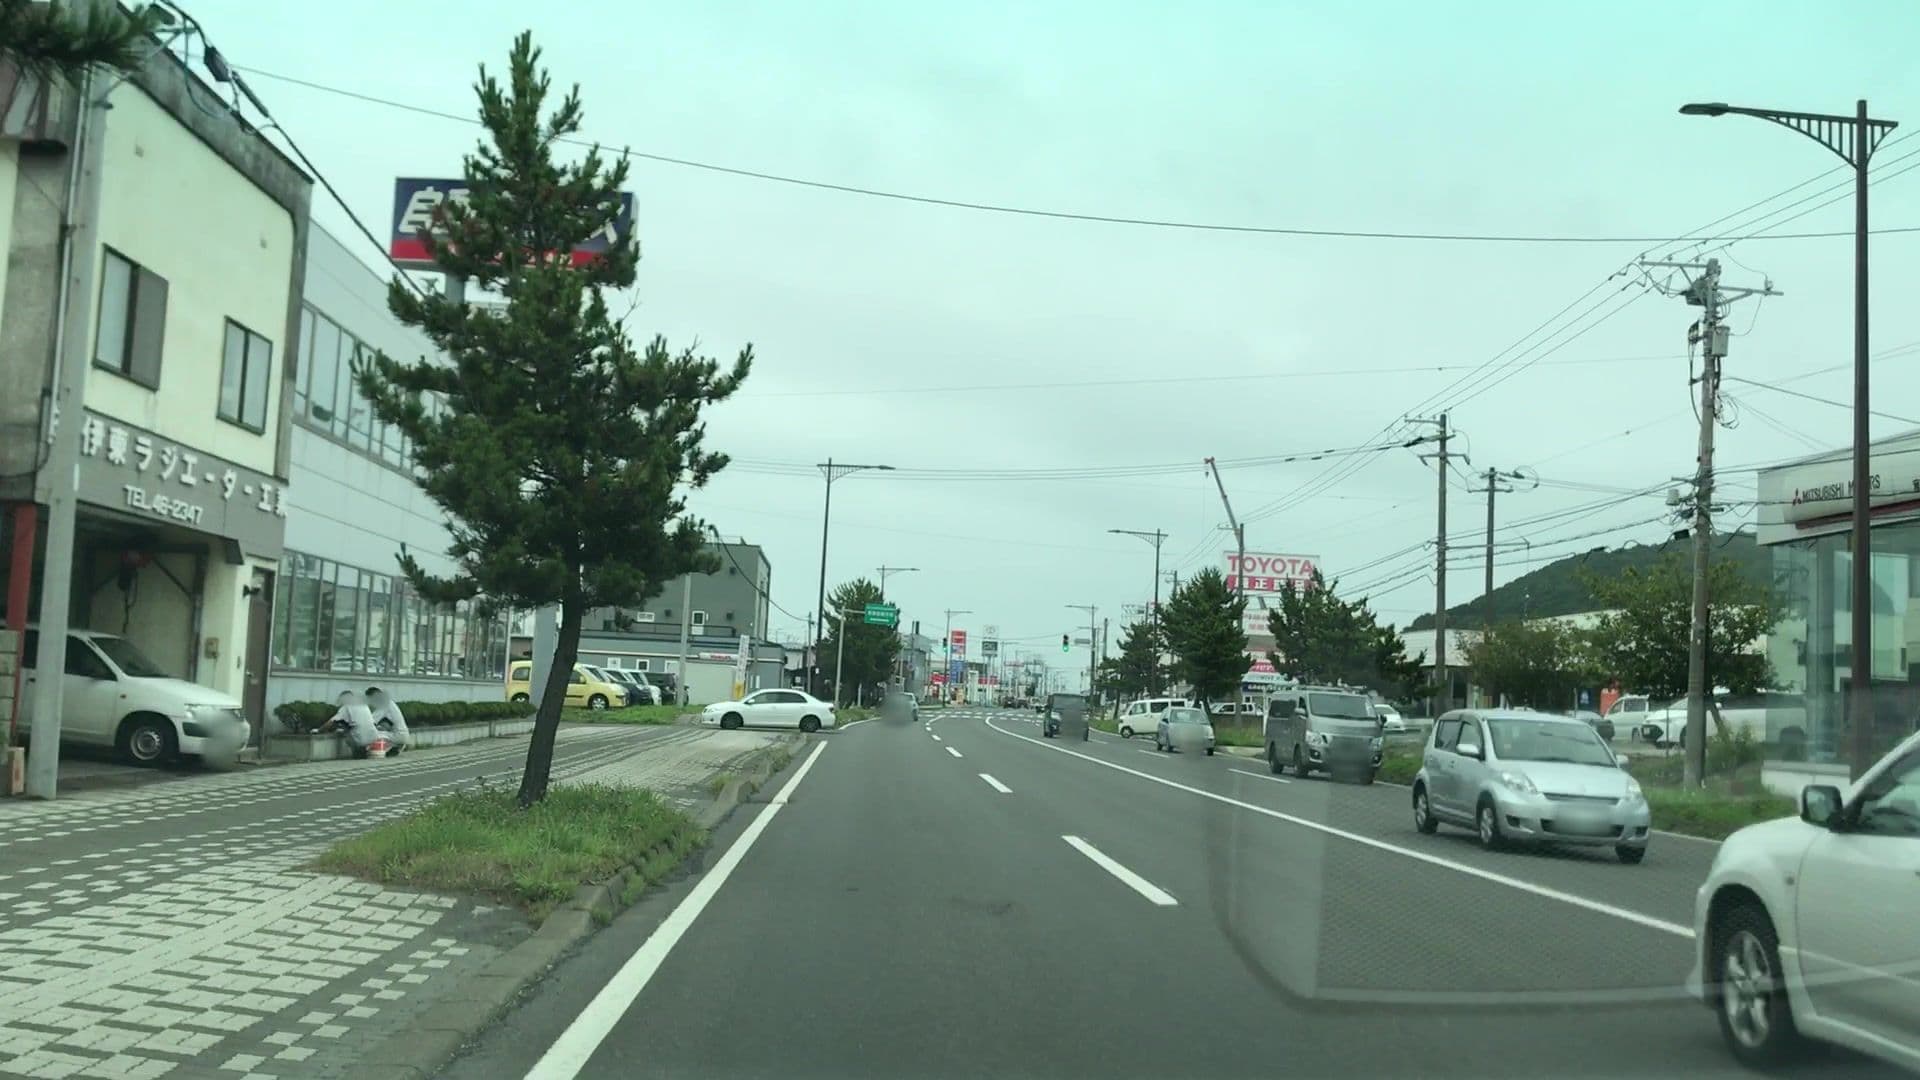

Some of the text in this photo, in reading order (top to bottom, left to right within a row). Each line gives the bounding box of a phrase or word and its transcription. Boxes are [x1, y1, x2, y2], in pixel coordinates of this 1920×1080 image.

[1802, 474, 1881, 502] MITSUBISHI MRS
[1227, 555, 1313, 577] TOYOTA
